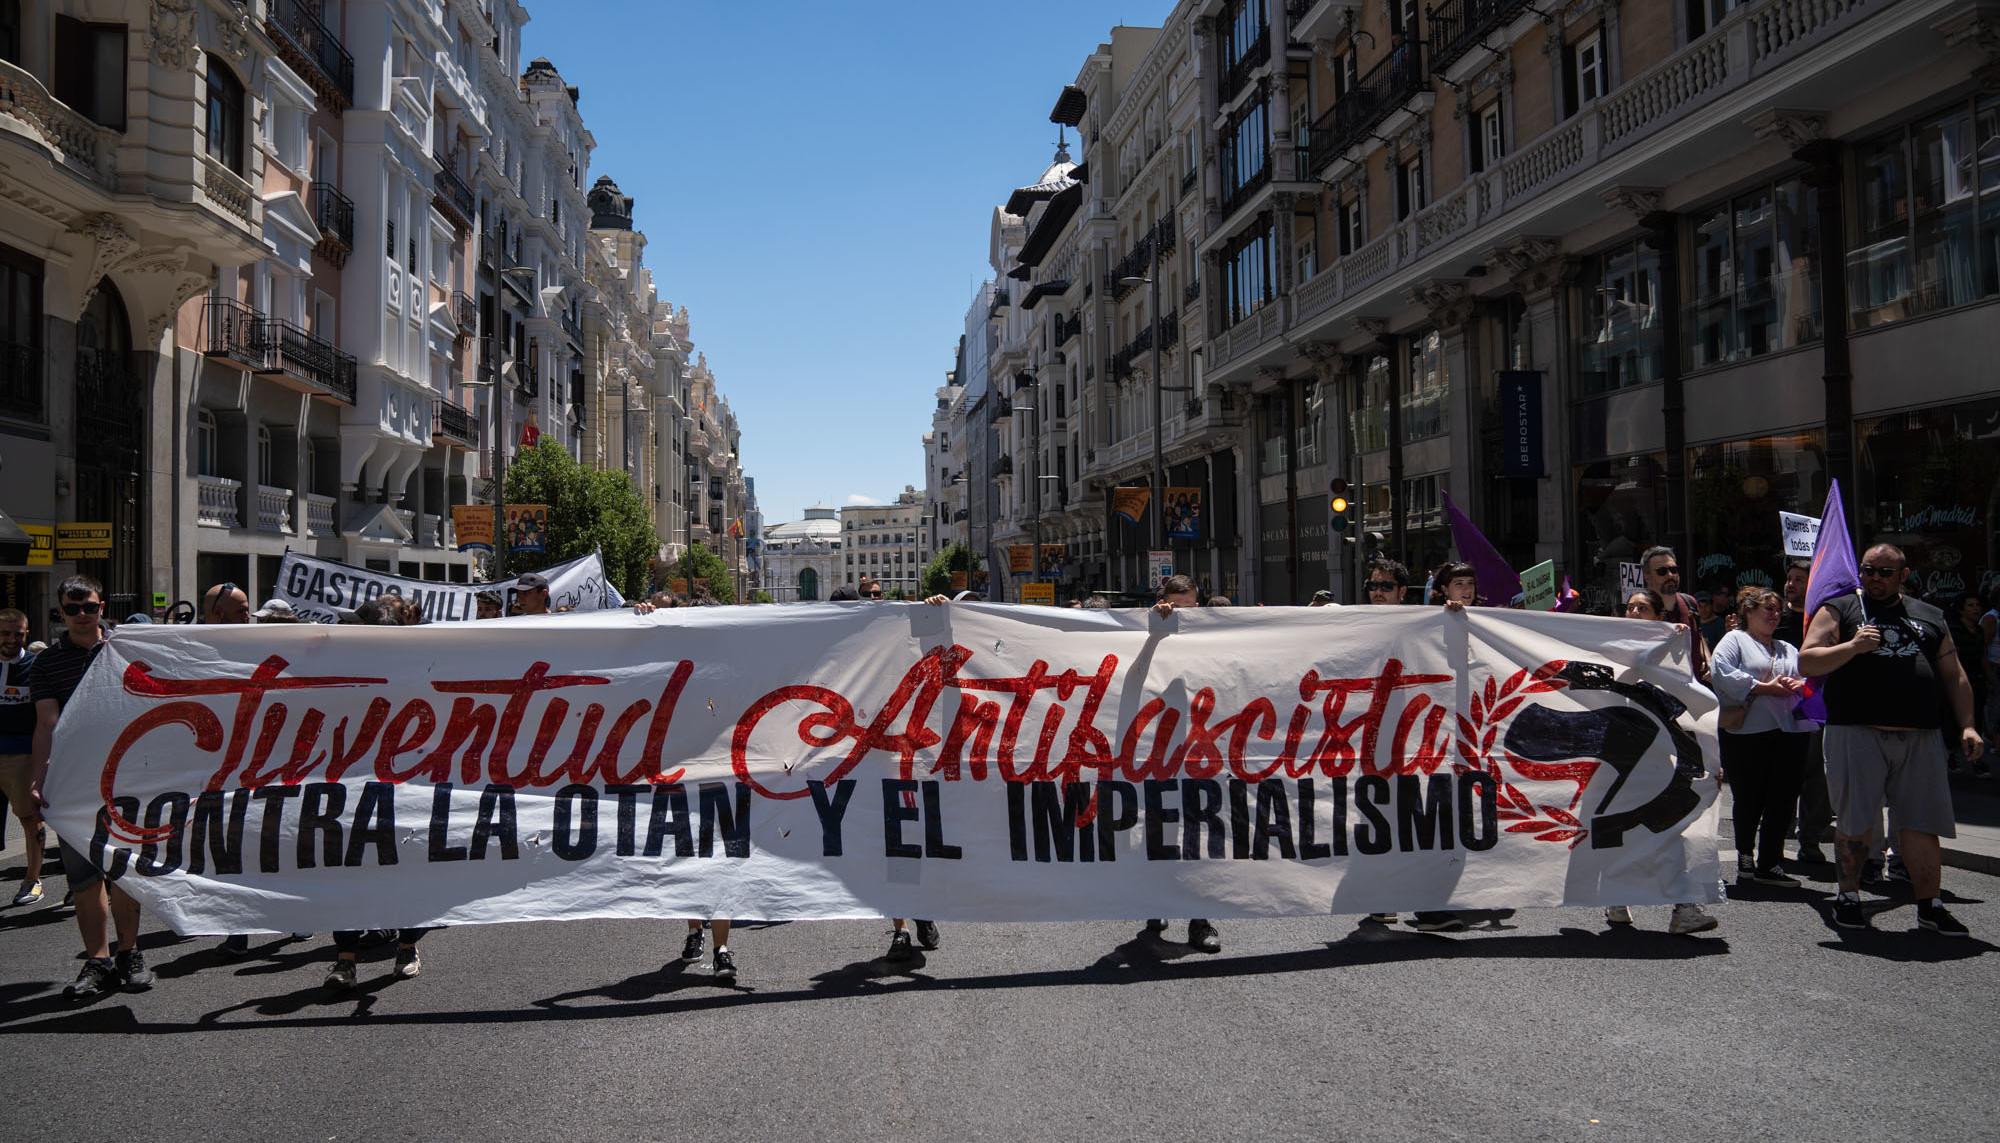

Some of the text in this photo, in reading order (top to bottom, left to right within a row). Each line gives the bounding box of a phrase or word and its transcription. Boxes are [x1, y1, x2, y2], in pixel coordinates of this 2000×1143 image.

[1518, 393, 1529, 467] IBEROSTAR
[1300, 524, 1329, 538] ASCAN
[1785, 517, 1810, 533] Guerras
[1791, 538, 1811, 551] todas
[1621, 563, 1643, 588] PAZ
[100, 644, 1454, 844] Juventud Antifascista
[90, 770, 1499, 881] CONTRA LA OTAN Y EL IMPERIALISMO
